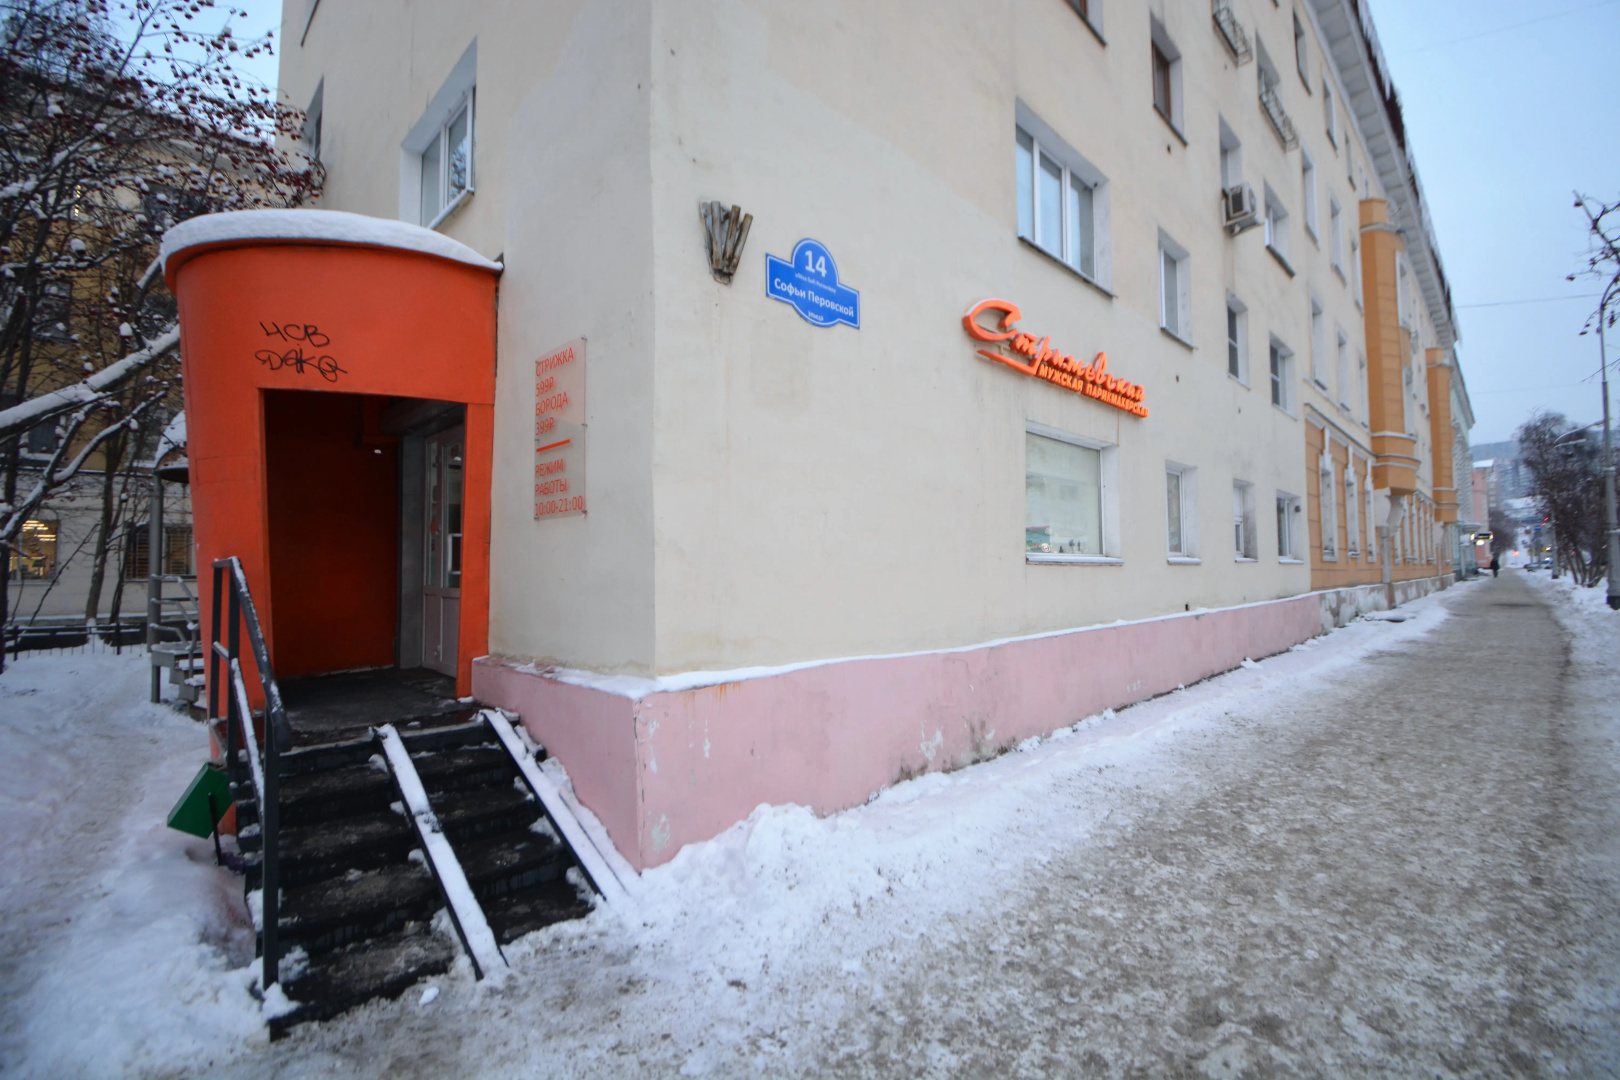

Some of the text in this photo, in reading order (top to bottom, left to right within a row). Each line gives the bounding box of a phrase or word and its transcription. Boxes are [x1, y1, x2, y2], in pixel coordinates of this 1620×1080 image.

[805, 250, 827, 277] 14
[774, 278, 854, 317] Софьи Перовской
[535, 347, 574, 377] СТРИЖКА
[1037, 363, 1150, 417] МУЖСКАЯ ПАРИКМАХЕРСКАЯ
[535, 391, 569, 416] БОРОДА
[535, 458, 564, 477] РЕЖИМ
[535, 478, 567, 497] РАБОТЫ
[535, 495, 584, 516] 10:00-21:00
